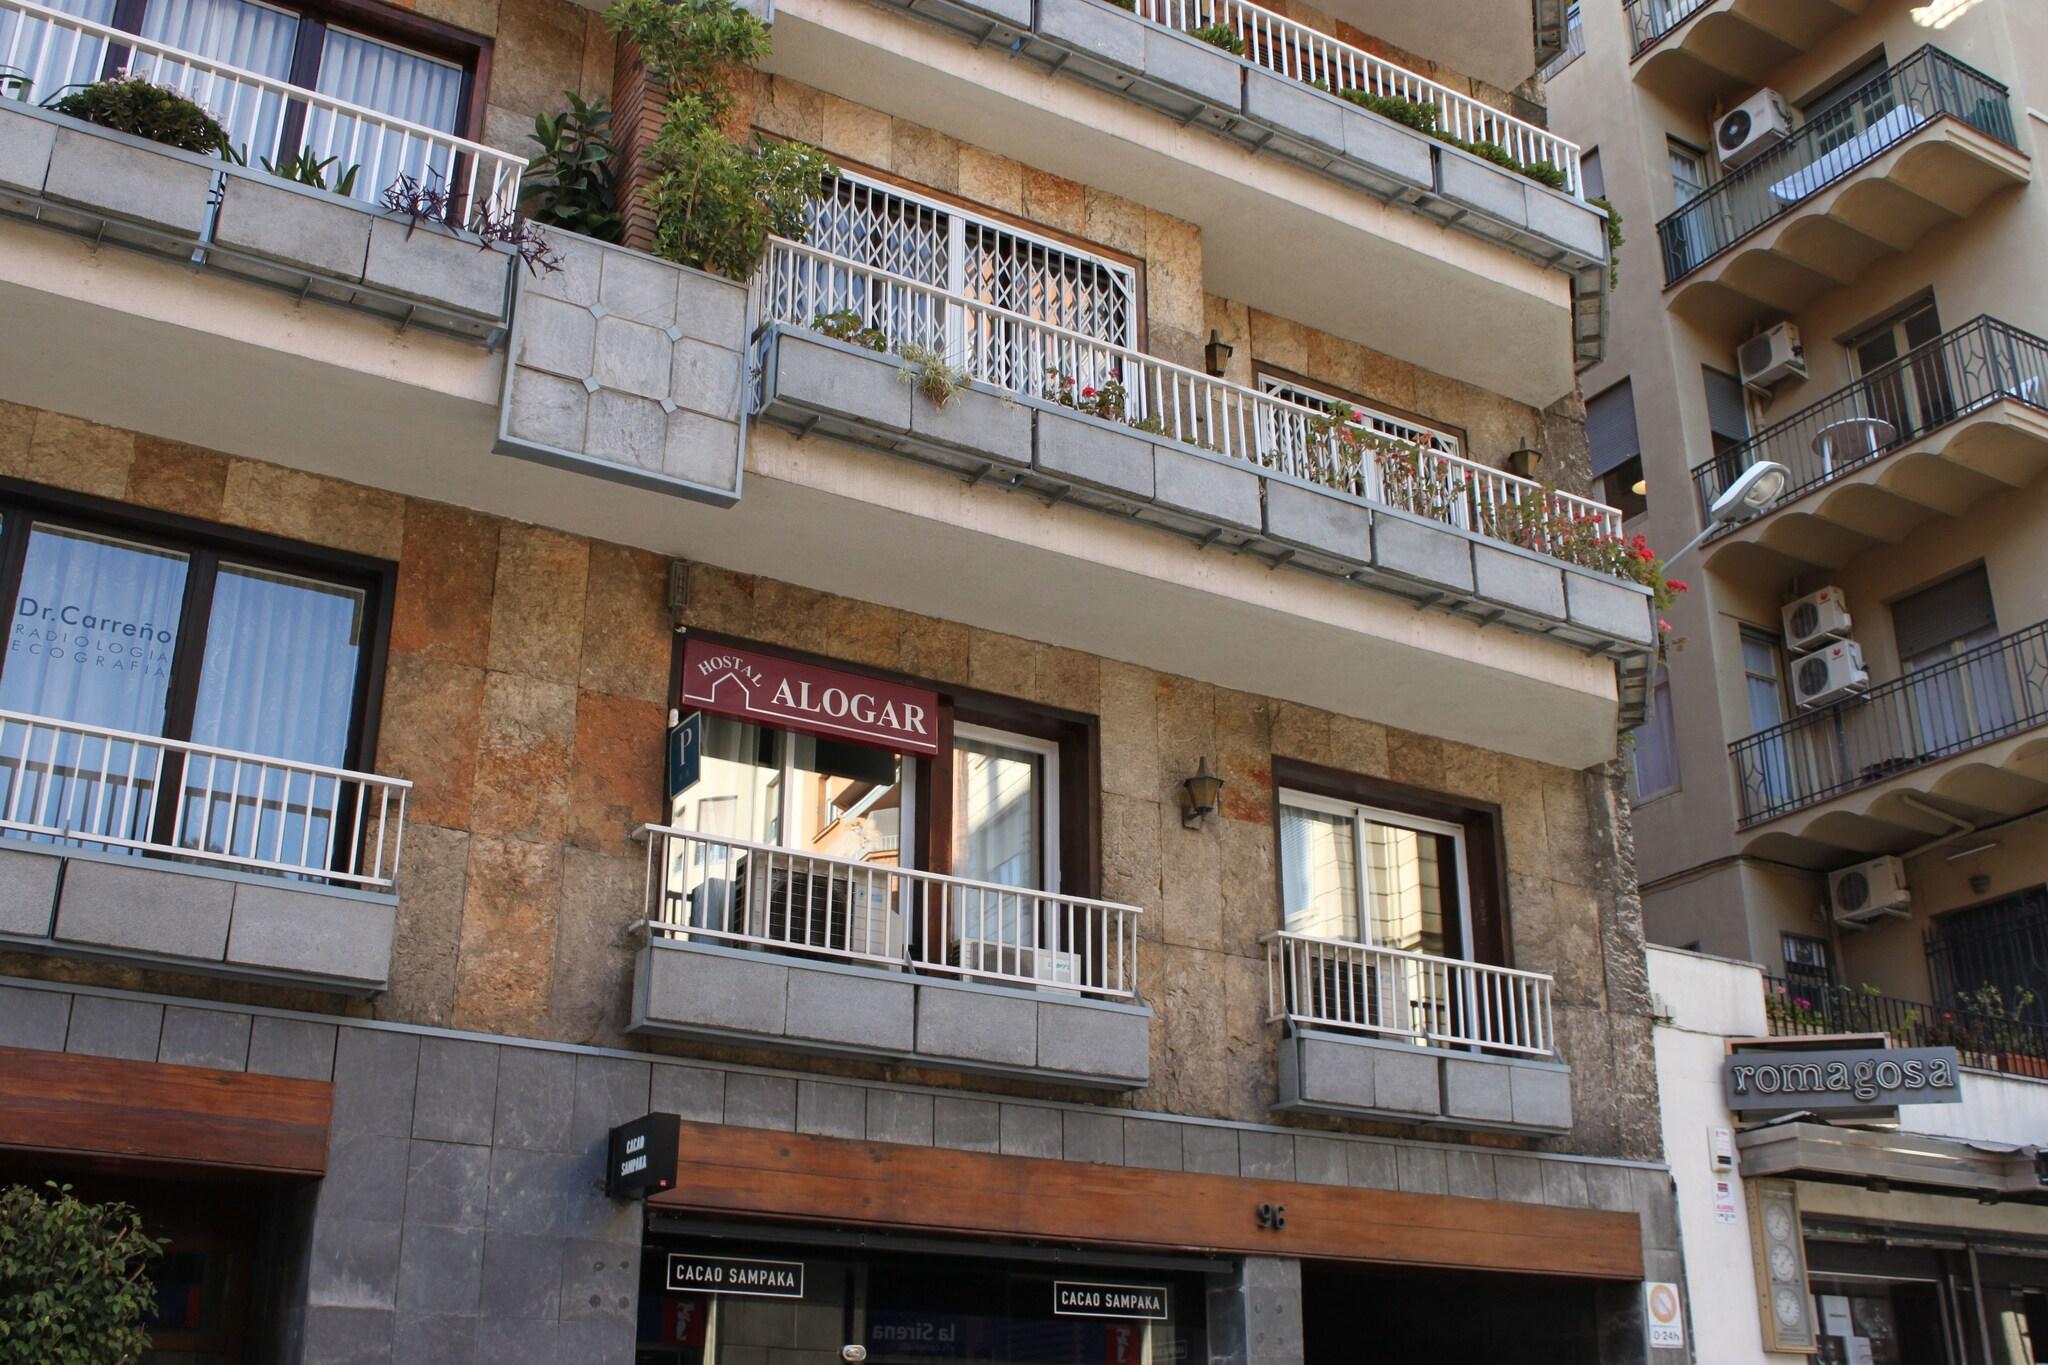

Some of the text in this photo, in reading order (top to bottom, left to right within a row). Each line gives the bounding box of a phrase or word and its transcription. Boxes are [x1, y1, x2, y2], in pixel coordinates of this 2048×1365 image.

[19, 597, 171, 644] Dr.Carreño
[12, 639, 165, 678] ECOGRAFIA
[15, 623, 168, 663] RADIOLOGIA
[698, 655, 763, 688] HOSTAL
[771, 677, 928, 735] ALOGAR
[679, 727, 692, 767] P
[1734, 1058, 1954, 1101] romagosa
[626, 1135, 645, 1154] CACAO
[621, 1154, 647, 1176] SAMPAKA
[1257, 1202, 1286, 1230] 96
[676, 1264, 795, 1288] CACAO SAMPAKA
[1061, 1291, 1161, 1310] CACAO SAMPAKA
